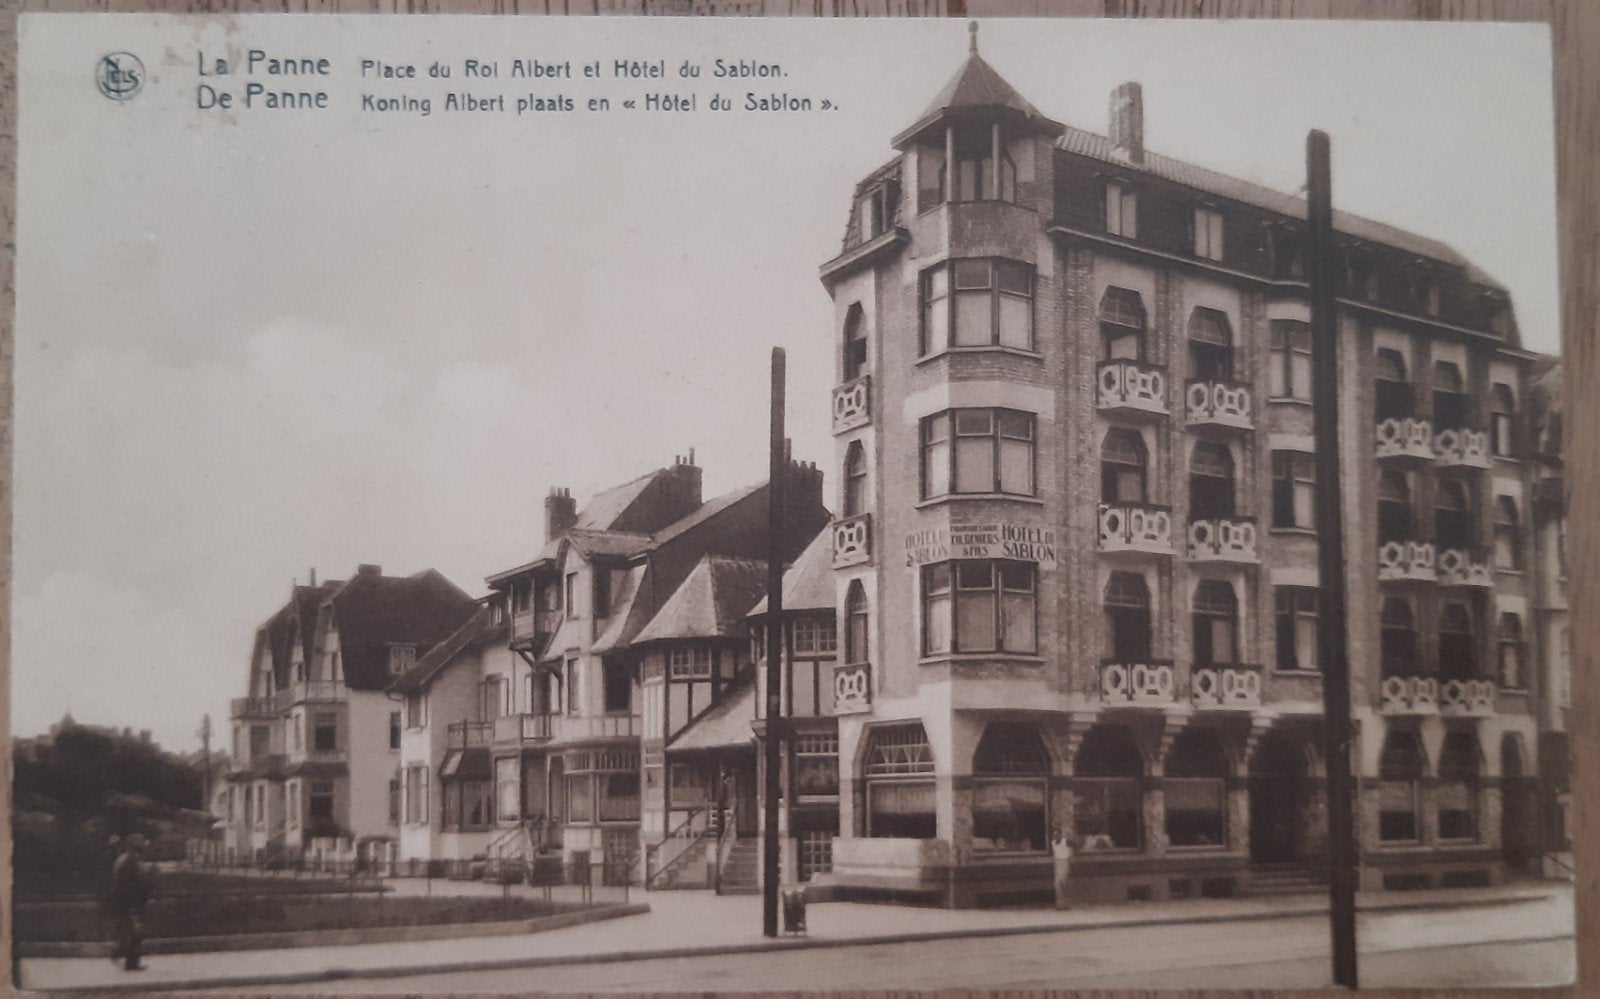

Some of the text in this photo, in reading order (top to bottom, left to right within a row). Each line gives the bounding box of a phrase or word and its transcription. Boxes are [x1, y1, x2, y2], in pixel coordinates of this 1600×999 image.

[198, 49, 330, 76] La Panne
[361, 58, 788, 79] Place du Roi Albert et Hôtel du Sablon.
[197, 83, 328, 110] De Panne
[362, 94, 431, 117] Koning
[445, 93, 504, 112] Albert
[517, 93, 574, 116] plaats
[588, 98, 609, 112] en
[645, 93, 696, 112] Hôtel
[709, 93, 731, 112] du
[744, 92, 811, 112] Sablon
[1002, 524, 1043, 545] HOTEL
[1002, 541, 1055, 562] SABLON
